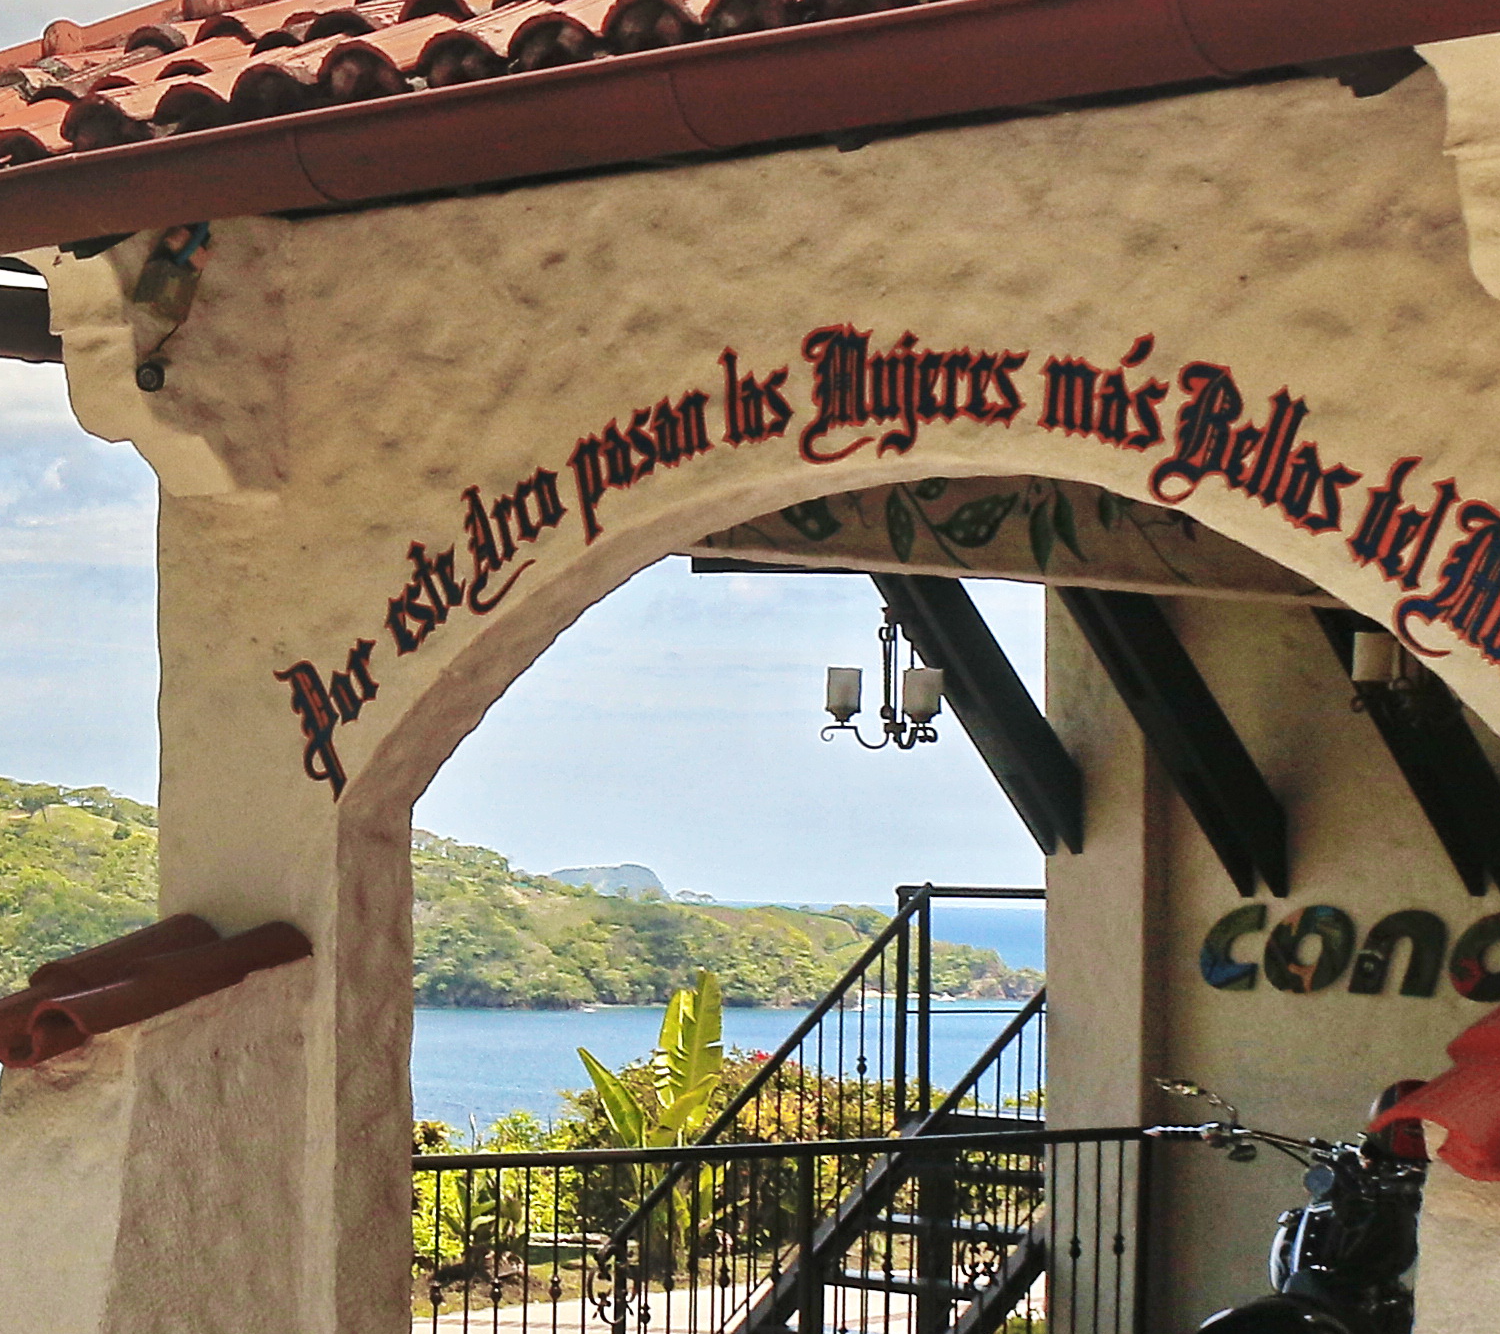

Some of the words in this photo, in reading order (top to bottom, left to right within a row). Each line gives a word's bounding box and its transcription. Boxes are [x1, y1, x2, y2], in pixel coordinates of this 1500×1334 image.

[384, 540, 466, 657] este
[459, 467, 567, 616] Arco
[567, 388, 712, 545] pasan
[716, 346, 793, 449] las
[799, 323, 1029, 465] Mujeres
[1037, 332, 1170, 451] más
[1148, 360, 1363, 530] Bellas
[1345, 455, 1456, 592] del
